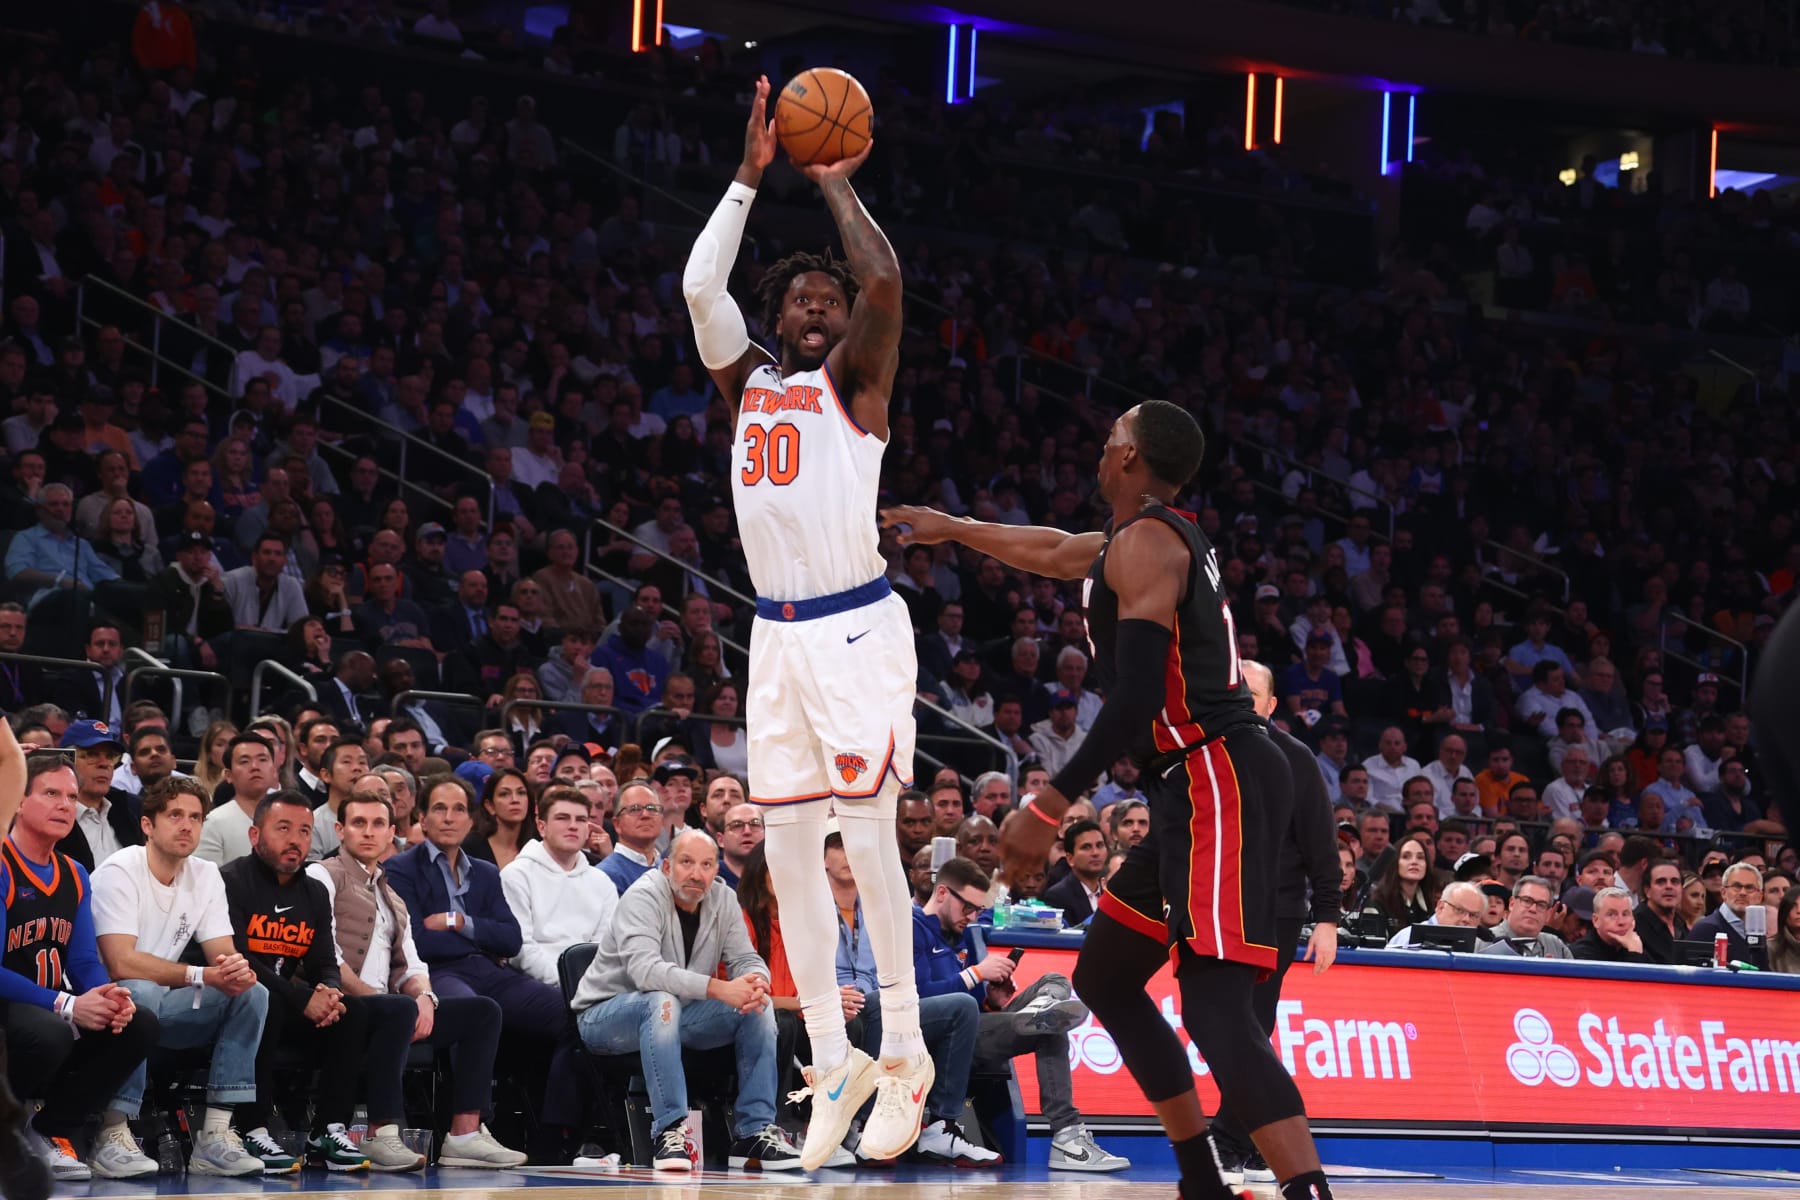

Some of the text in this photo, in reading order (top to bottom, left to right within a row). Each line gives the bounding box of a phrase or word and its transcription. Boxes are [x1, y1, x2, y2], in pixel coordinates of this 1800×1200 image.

[781, 384, 823, 415] ORK
[741, 422, 801, 487] 30
[1221, 600, 1245, 690] 1
[7, 916, 73, 952] NEW YOR
[36, 947, 63, 990] 11
